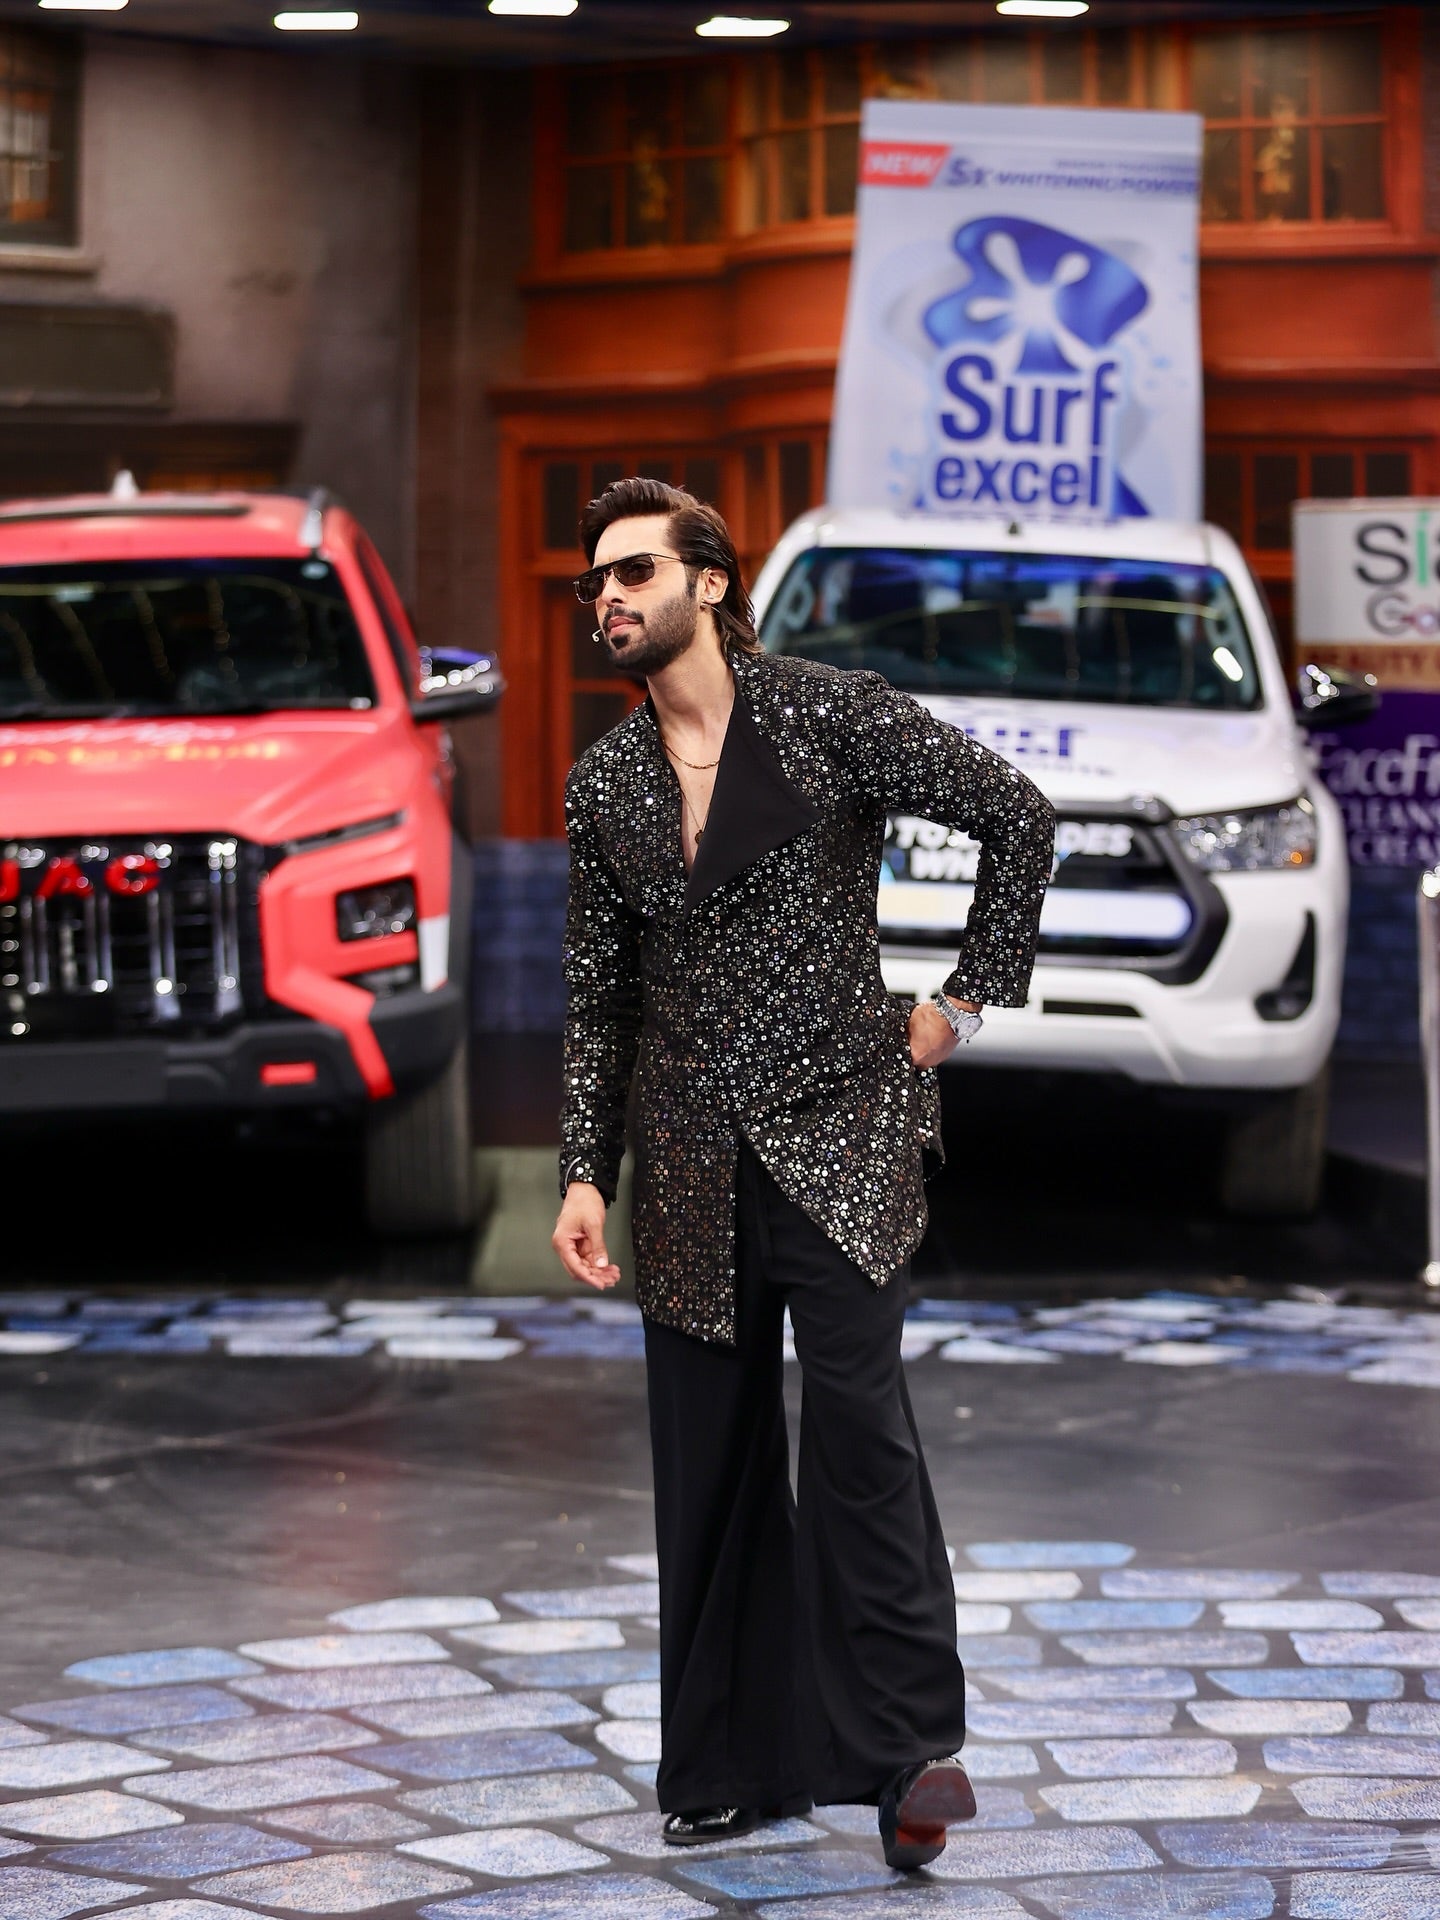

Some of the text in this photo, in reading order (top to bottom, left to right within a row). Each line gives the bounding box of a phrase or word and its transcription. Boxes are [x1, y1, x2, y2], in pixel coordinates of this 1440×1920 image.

[866, 153, 942, 177] NEW
[940, 354, 1116, 446] Surf
[935, 455, 1100, 508] excel
[1354, 508, 1440, 588] Si
